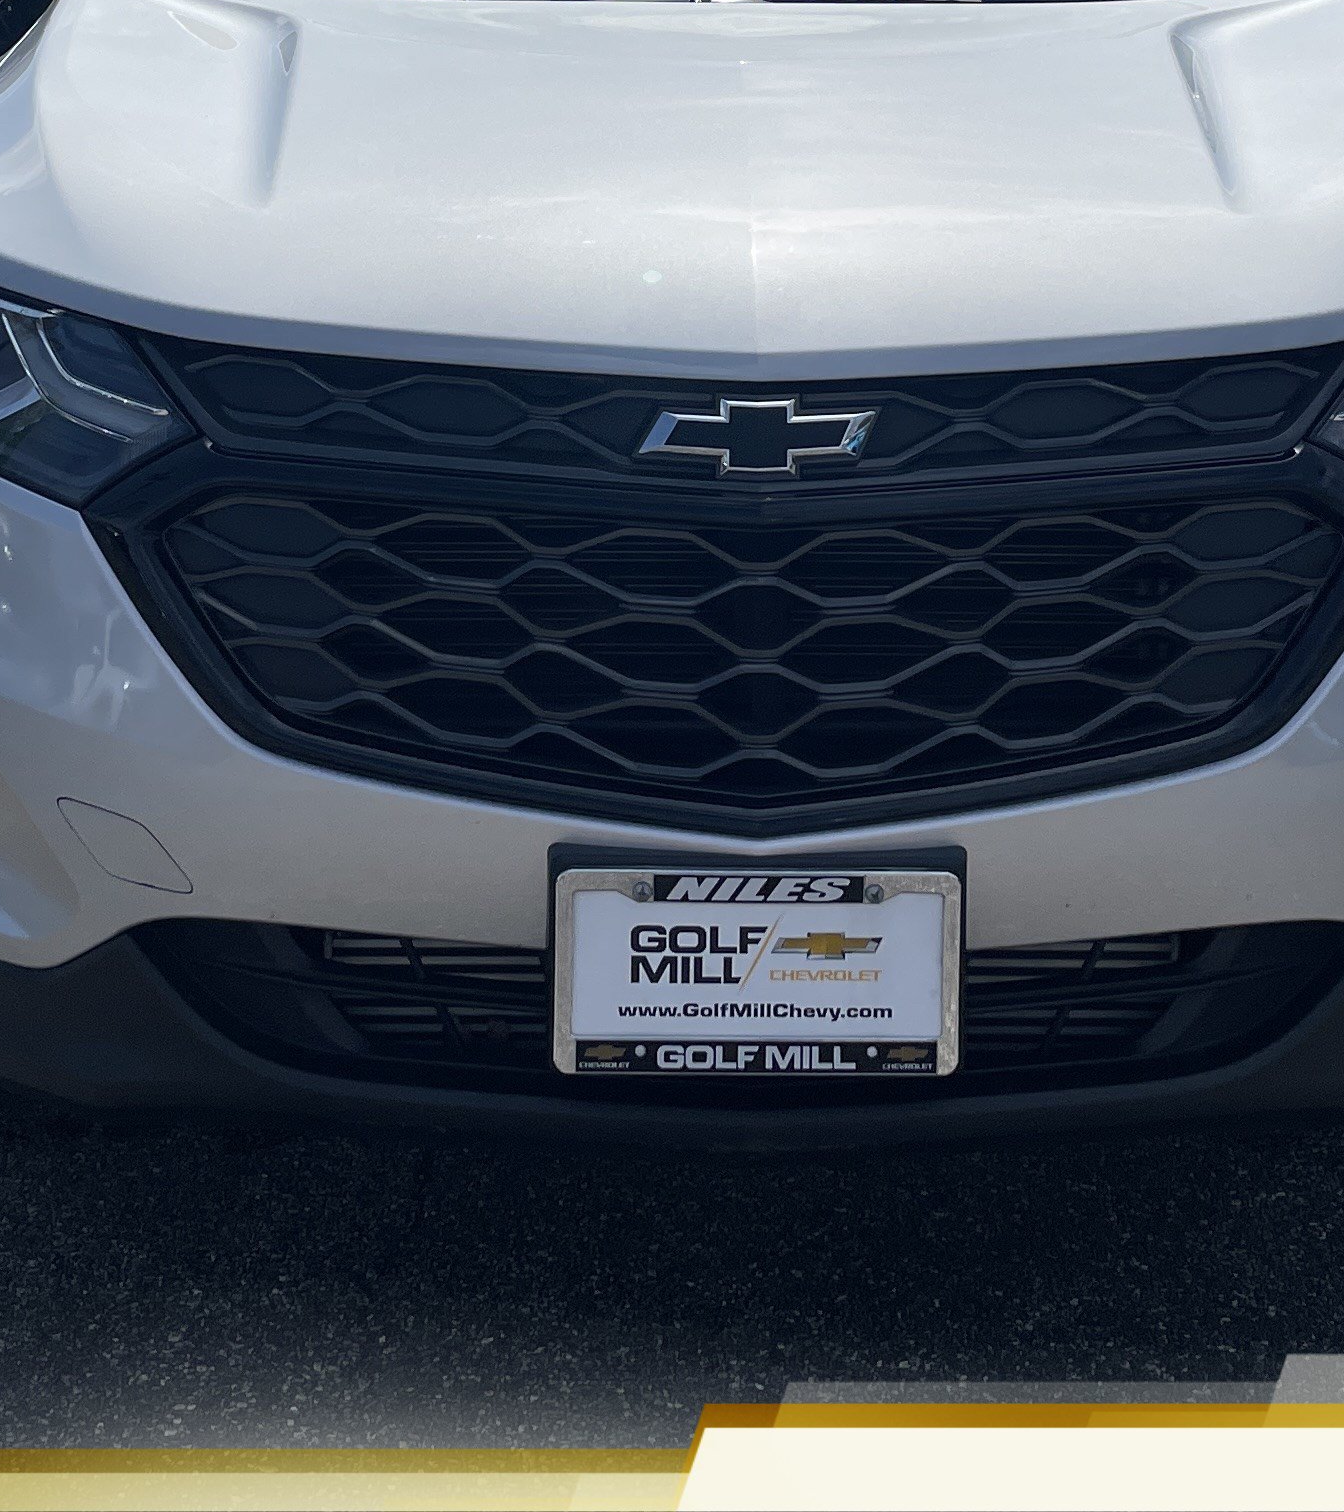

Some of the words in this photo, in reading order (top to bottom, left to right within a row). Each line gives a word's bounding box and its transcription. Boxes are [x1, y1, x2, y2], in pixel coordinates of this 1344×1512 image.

[666, 877, 850, 902] NILES
[630, 925, 768, 954] GOLF
[630, 955, 742, 984] MILL
[769, 969, 883, 982] CHEVROLET
[618, 1003, 893, 1021] www.GolfMillChevy.com
[657, 1045, 759, 1070] GOLF
[765, 1045, 856, 1070] MILL
